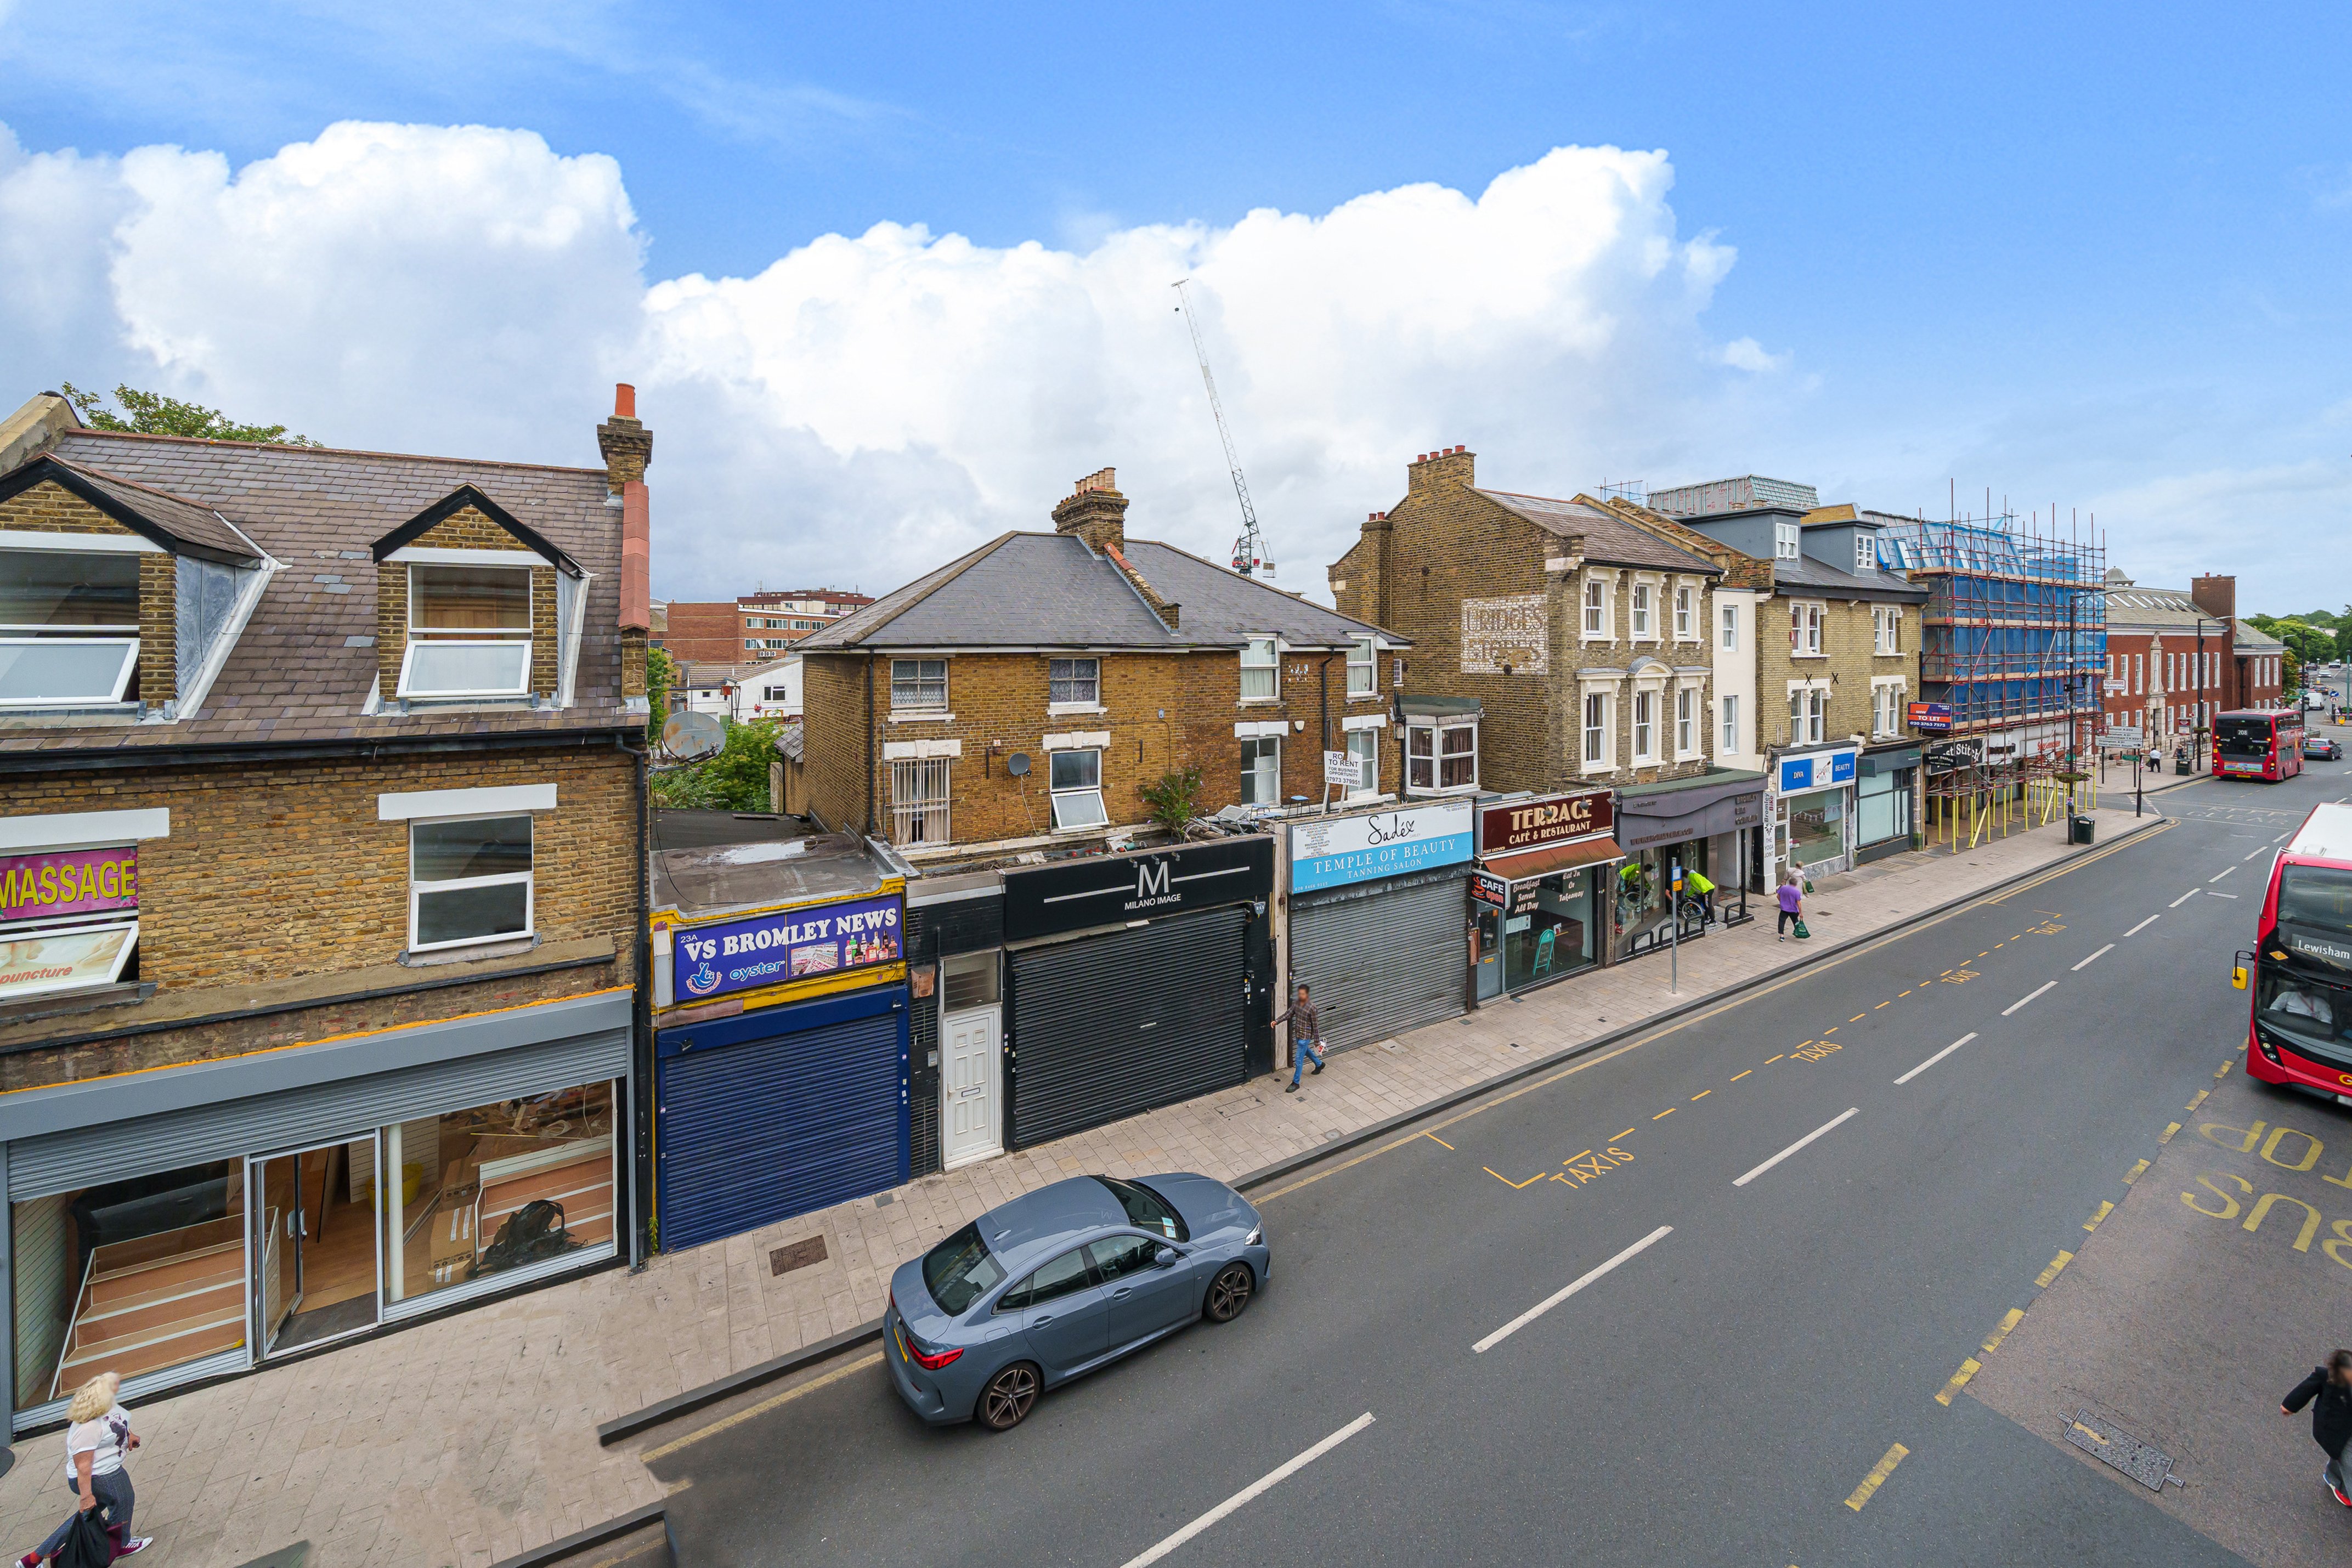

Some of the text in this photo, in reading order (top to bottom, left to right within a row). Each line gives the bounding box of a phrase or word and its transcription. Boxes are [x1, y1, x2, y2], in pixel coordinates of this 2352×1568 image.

[1835, 763, 1851, 772] BEAUTY
[1509, 820, 1591, 845] CAFÉ & RESTAURANT
[1314, 839, 1456, 874] TEMPLE OF BEAUTY
[1347, 858, 1422, 879] TANNING SALON
[0, 860, 136, 908] MASSAGE
[1138, 861, 1169, 897] M
[1480, 878, 1504, 893] CAFE
[1513, 879, 1540, 893] Breakfast
[1124, 893, 1181, 910] MILANO IMAGE
[1486, 890, 1504, 903] open
[1518, 890, 1535, 902] Served
[1559, 890, 1584, 902] Takeaway
[1514, 902, 1539, 914] All Day
[680, 934, 698, 944] 23A
[685, 908, 897, 962] VS BROMLEY NEWS
[2034, 924, 2067, 936] TAXIS
[2298, 939, 2350, 959] Lewisham
[730, 961, 785, 982] oyster
[813, 960, 827, 970] Sun
[0, 965, 73, 984] puncture
[691, 986, 711, 994] National
[710, 972, 723, 991] Lottery
[1941, 970, 1980, 985] TAXIS
[1789, 1040, 1843, 1063] TAXIS
[1548, 1147, 1635, 1189] TAXIS
